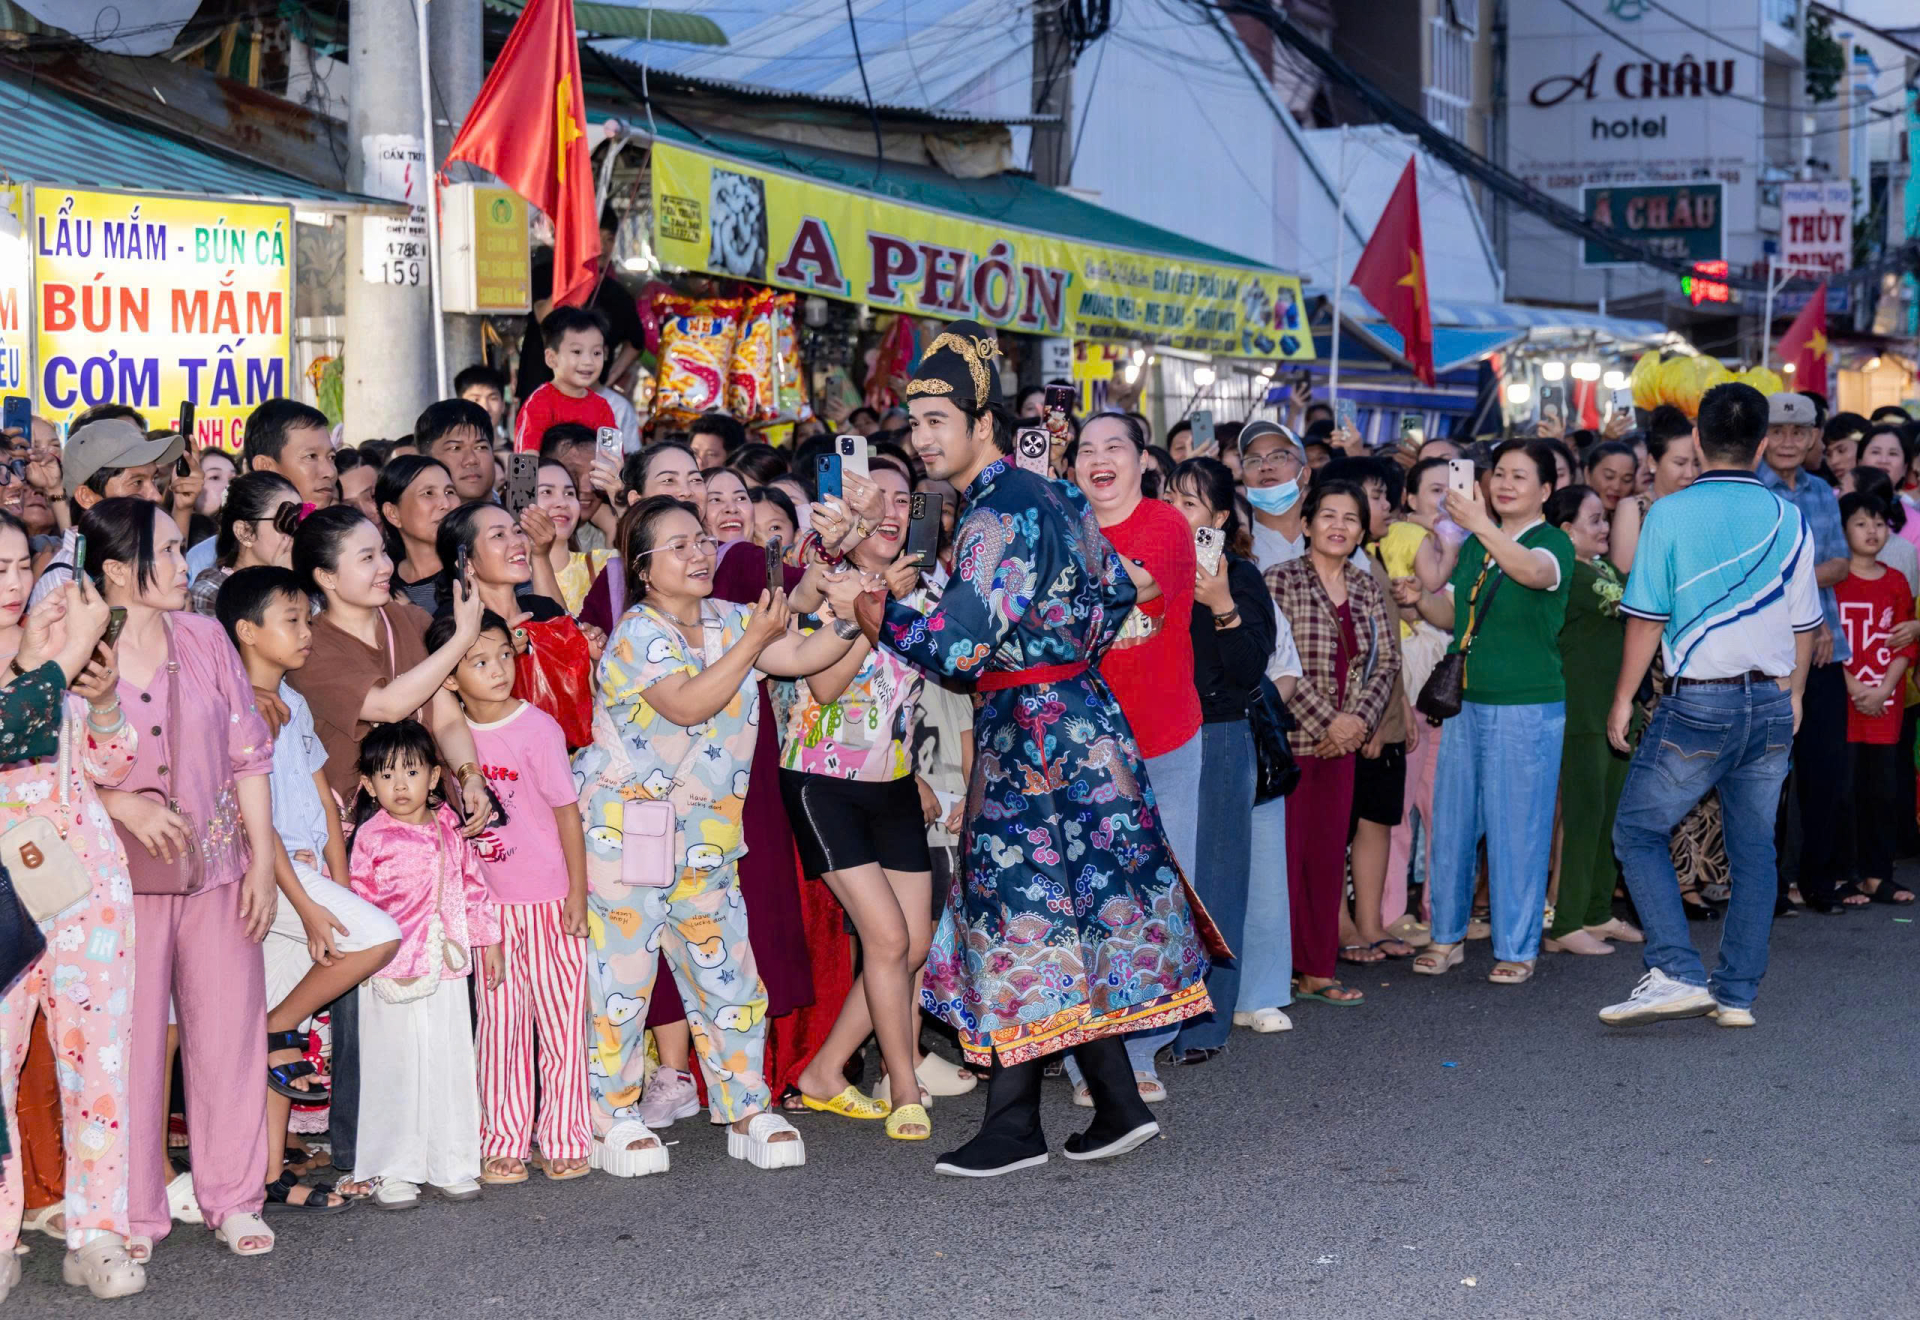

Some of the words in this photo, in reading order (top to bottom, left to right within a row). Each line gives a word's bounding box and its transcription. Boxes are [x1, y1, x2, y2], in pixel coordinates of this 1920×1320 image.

[1614, 53, 1736, 98] CHÂU
[1592, 115, 1667, 140] hotel
[1626, 189, 1716, 229] CHÂU
[39, 197, 92, 258] LẨU
[104, 206, 167, 261] MẮM
[195, 218, 245, 264] BÚN
[255, 220, 285, 266] CÁ
[382, 261, 420, 287] 159
[777, 217, 848, 294] A
[867, 231, 1070, 330] PHÓN
[43, 272, 149, 333] BÚN
[171, 270, 282, 335] MẮM
[43, 349, 159, 409] CƠM
[179, 338, 283, 406] TẤM
[482, 764, 518, 781] Life
[690, 793, 707, 801] Have
